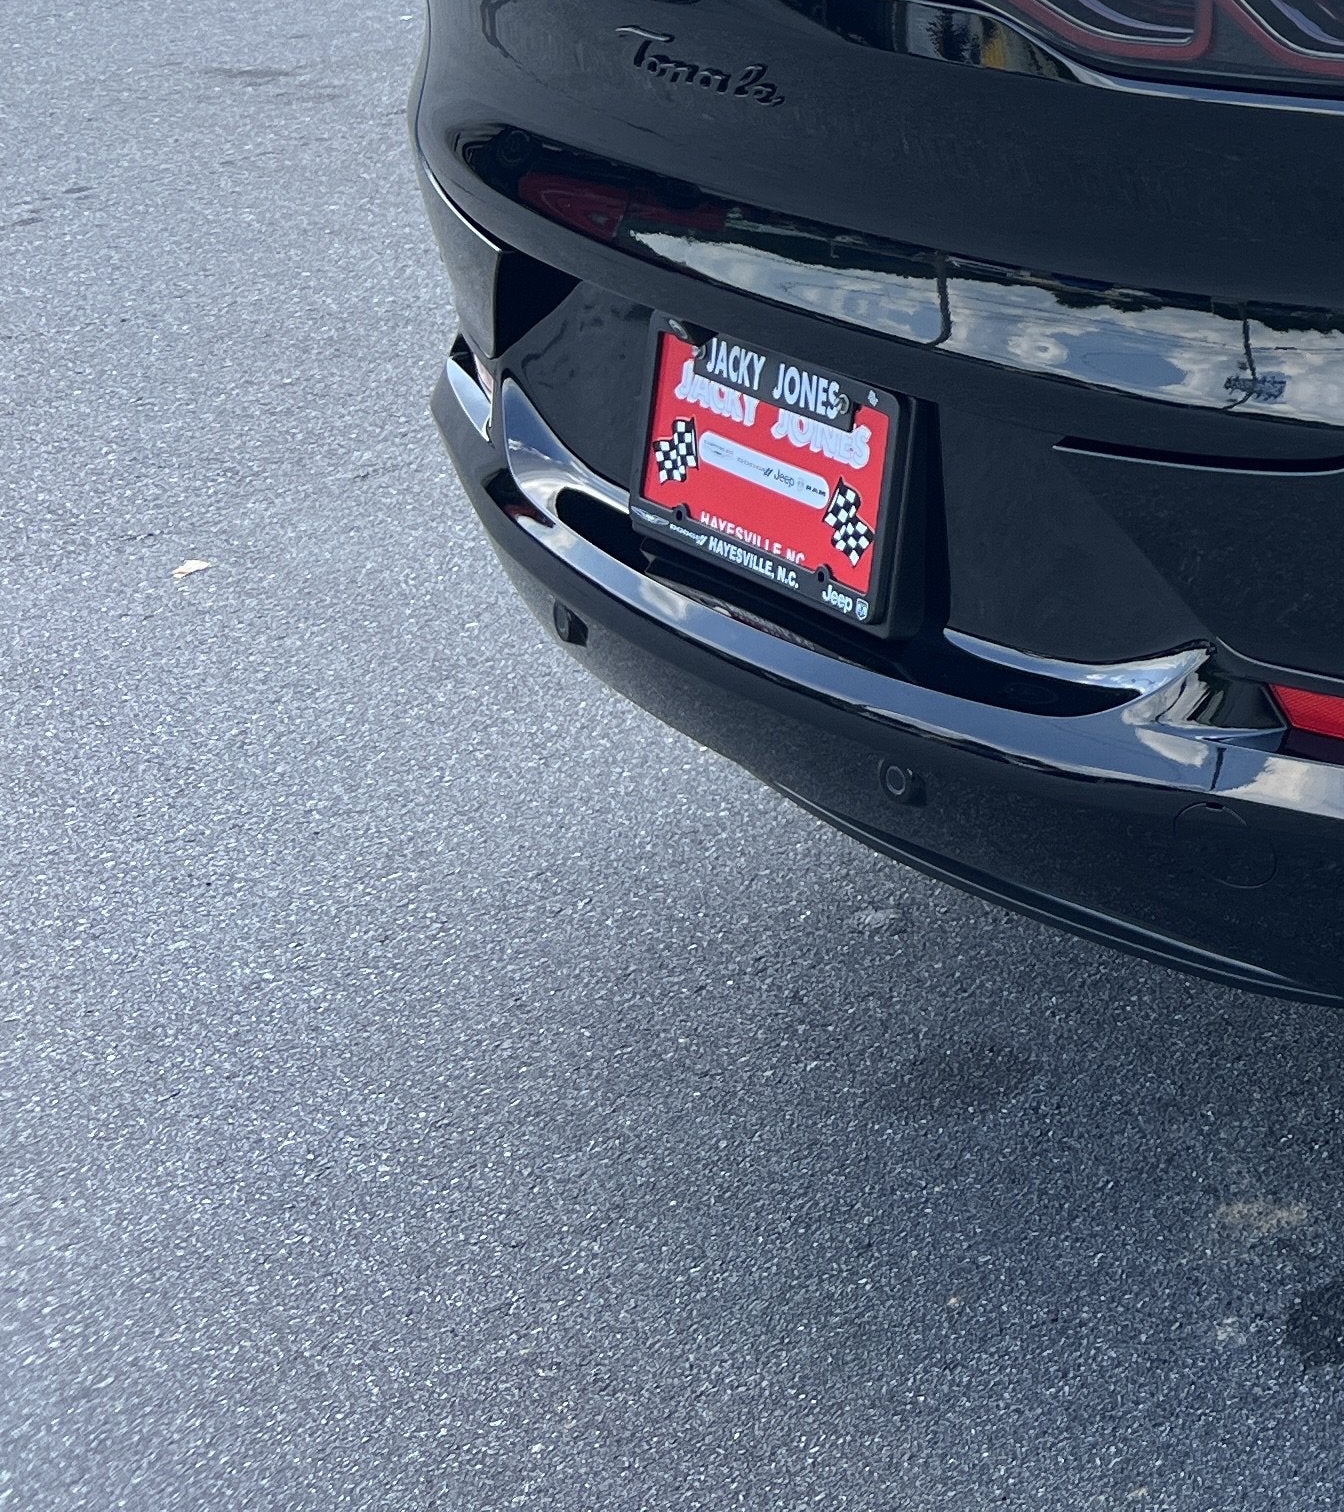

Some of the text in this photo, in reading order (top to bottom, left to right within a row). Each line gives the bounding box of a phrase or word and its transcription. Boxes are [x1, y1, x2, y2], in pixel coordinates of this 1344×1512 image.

[615, 24, 786, 107] Tonale
[706, 337, 841, 420] JACKY JONES
[674, 358, 872, 470] JACKY JONES
[773, 468, 795, 488] Jeep
[708, 535, 800, 589] HAYESVILLE, N.C.
[821, 584, 853, 614] Jeep
